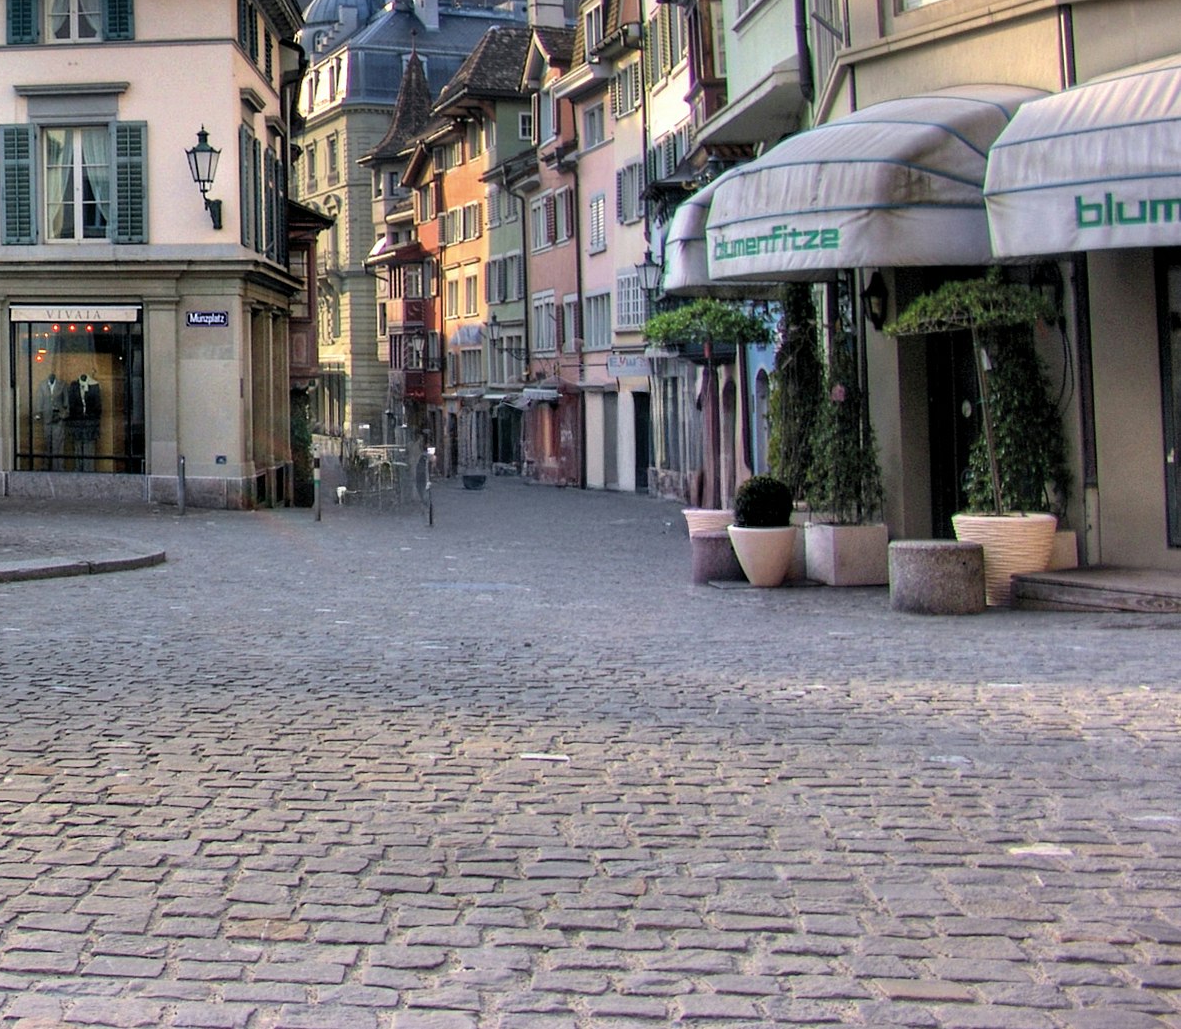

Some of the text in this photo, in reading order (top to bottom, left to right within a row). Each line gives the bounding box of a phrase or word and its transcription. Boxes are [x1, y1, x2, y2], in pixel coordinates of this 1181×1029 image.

[1075, 193, 1181, 229] blum
[714, 225, 839, 261] blumenfitze
[45, 310, 101, 320] VIVAIA
